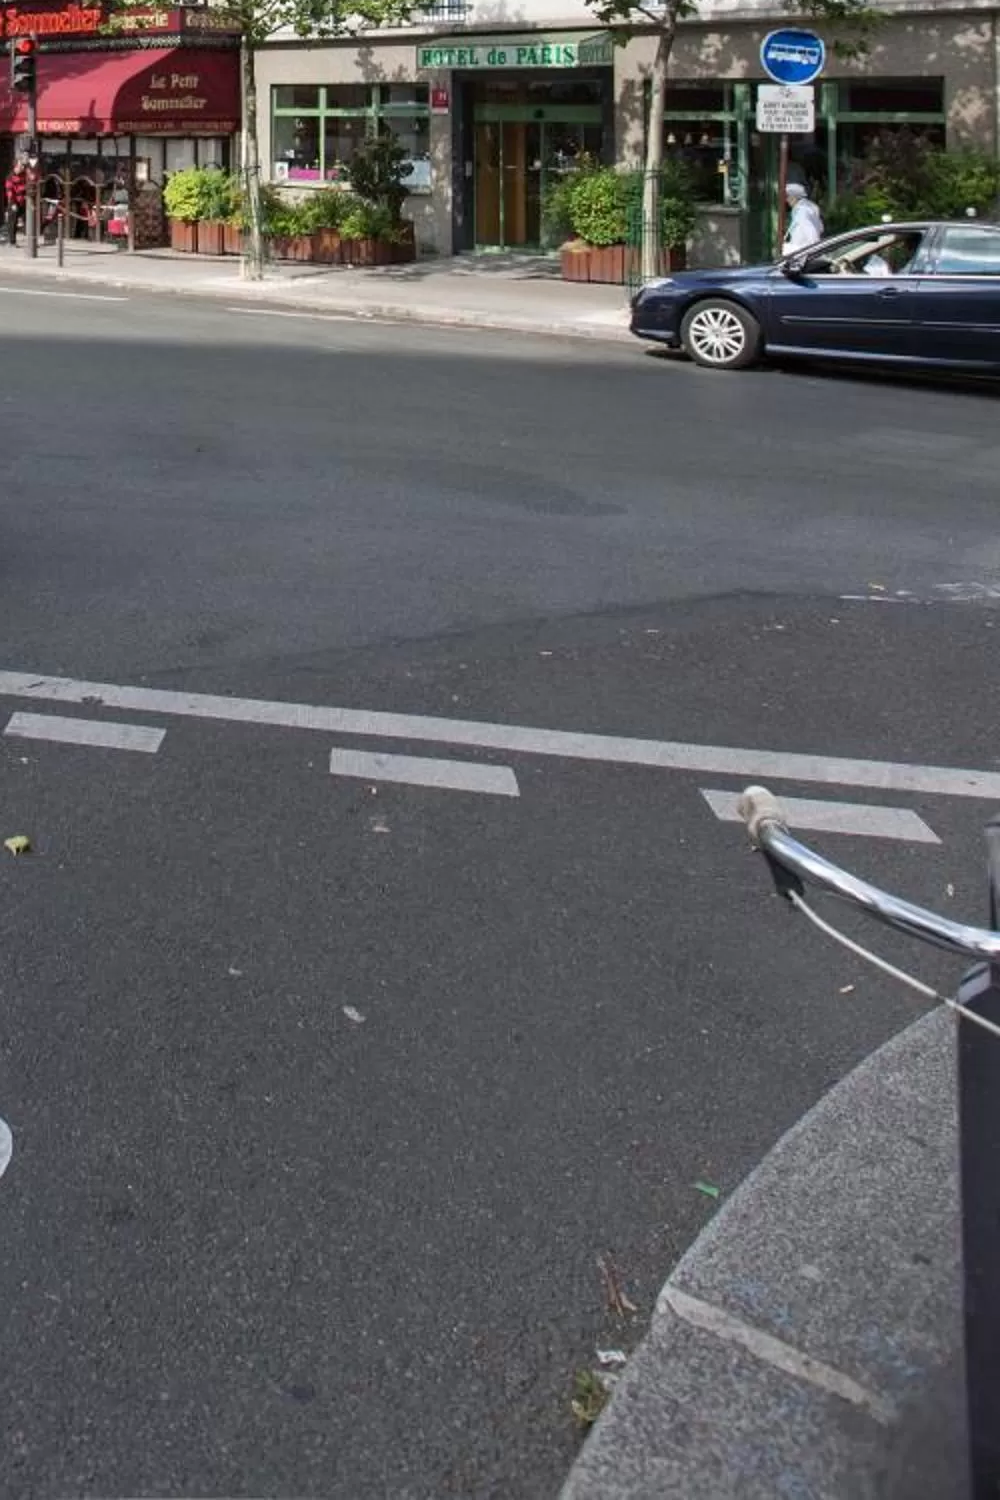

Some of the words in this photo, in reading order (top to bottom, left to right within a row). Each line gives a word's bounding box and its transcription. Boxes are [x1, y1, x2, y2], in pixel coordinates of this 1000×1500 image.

[6, 3, 101, 35] Sommelier
[421, 48, 479, 67] HOTEL
[488, 48, 506, 65] de
[516, 45, 576, 67] PARIS
[149, 73, 166, 89] Le
[171, 73, 199, 88] Petit
[141, 95, 208, 111] Sommelier
